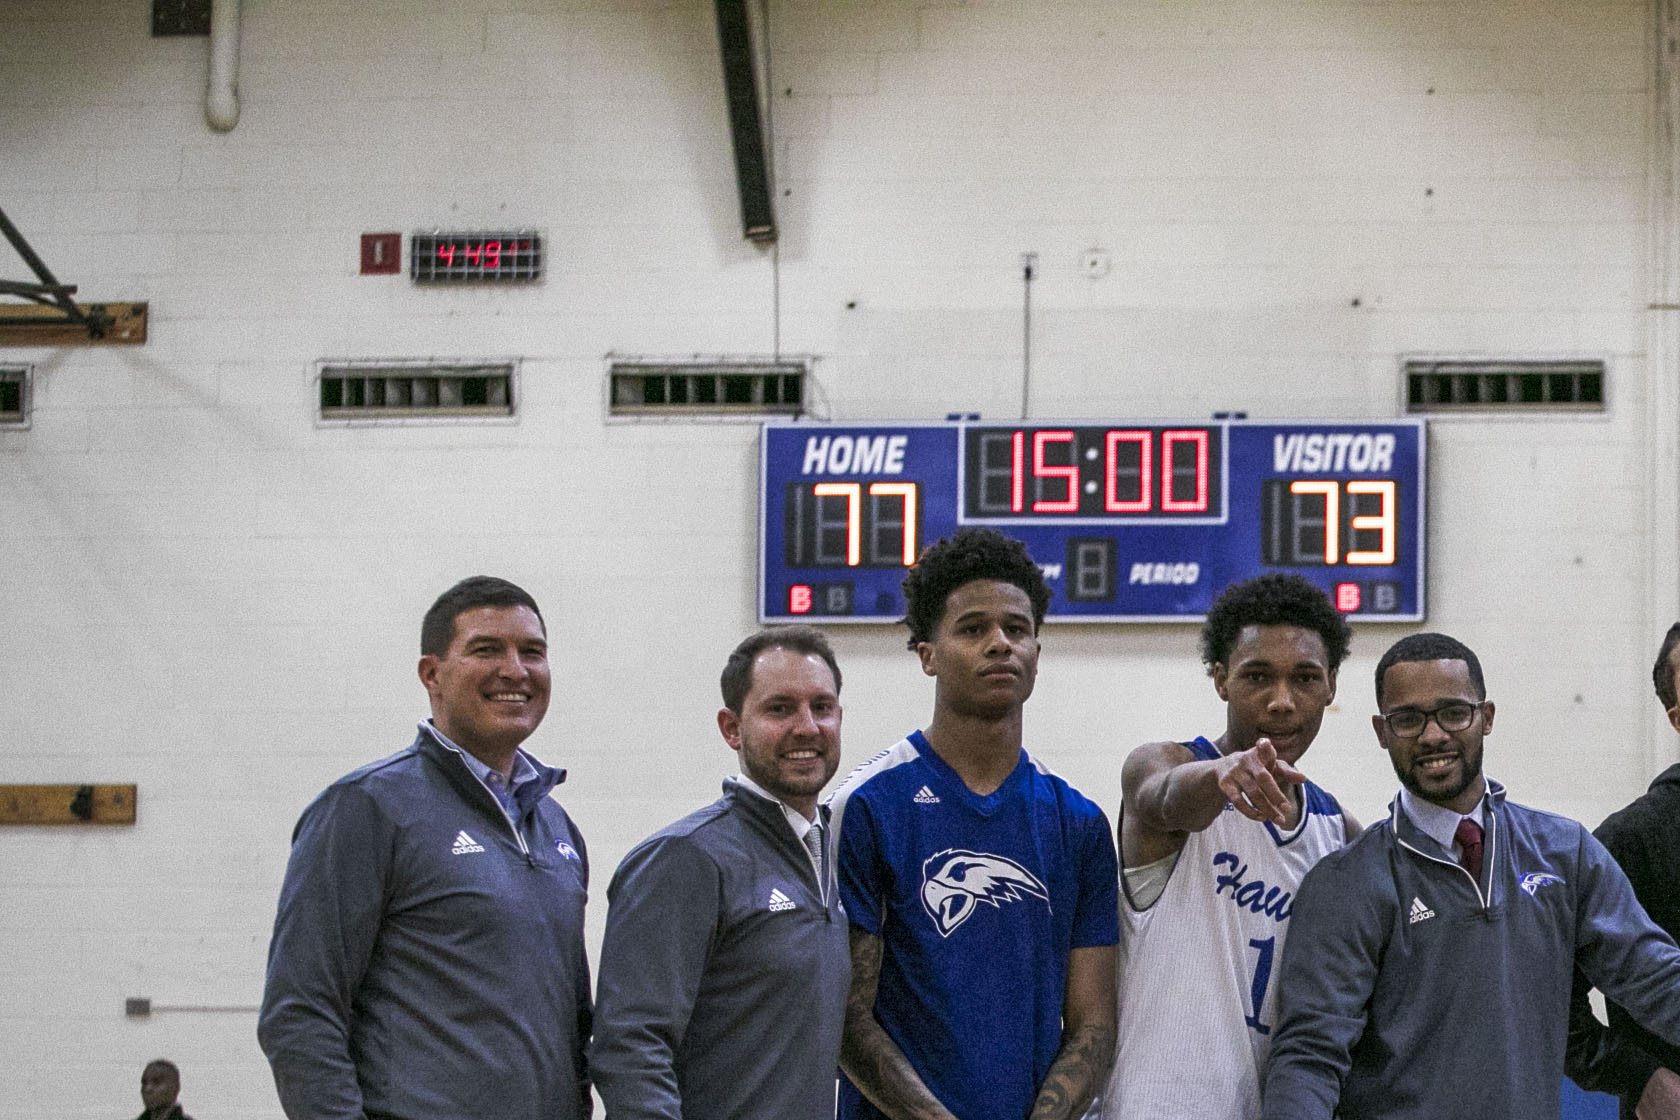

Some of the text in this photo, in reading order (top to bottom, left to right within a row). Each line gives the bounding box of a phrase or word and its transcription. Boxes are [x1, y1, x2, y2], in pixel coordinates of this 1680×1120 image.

[802, 435, 908, 475] HOME
[1273, 433, 1396, 473] VISITOR
[1011, 431, 1209, 512] 15:00
[813, 482, 917, 567] 77
[1289, 480, 1396, 565] 73
[1129, 561, 1200, 585] PERIOD
[788, 584, 812, 613] B
[1336, 583, 1360, 612] B
[914, 796, 940, 804] adidas
[452, 844, 485, 855] adidas
[1213, 851, 1294, 922] Haw
[769, 901, 796, 912] adidas
